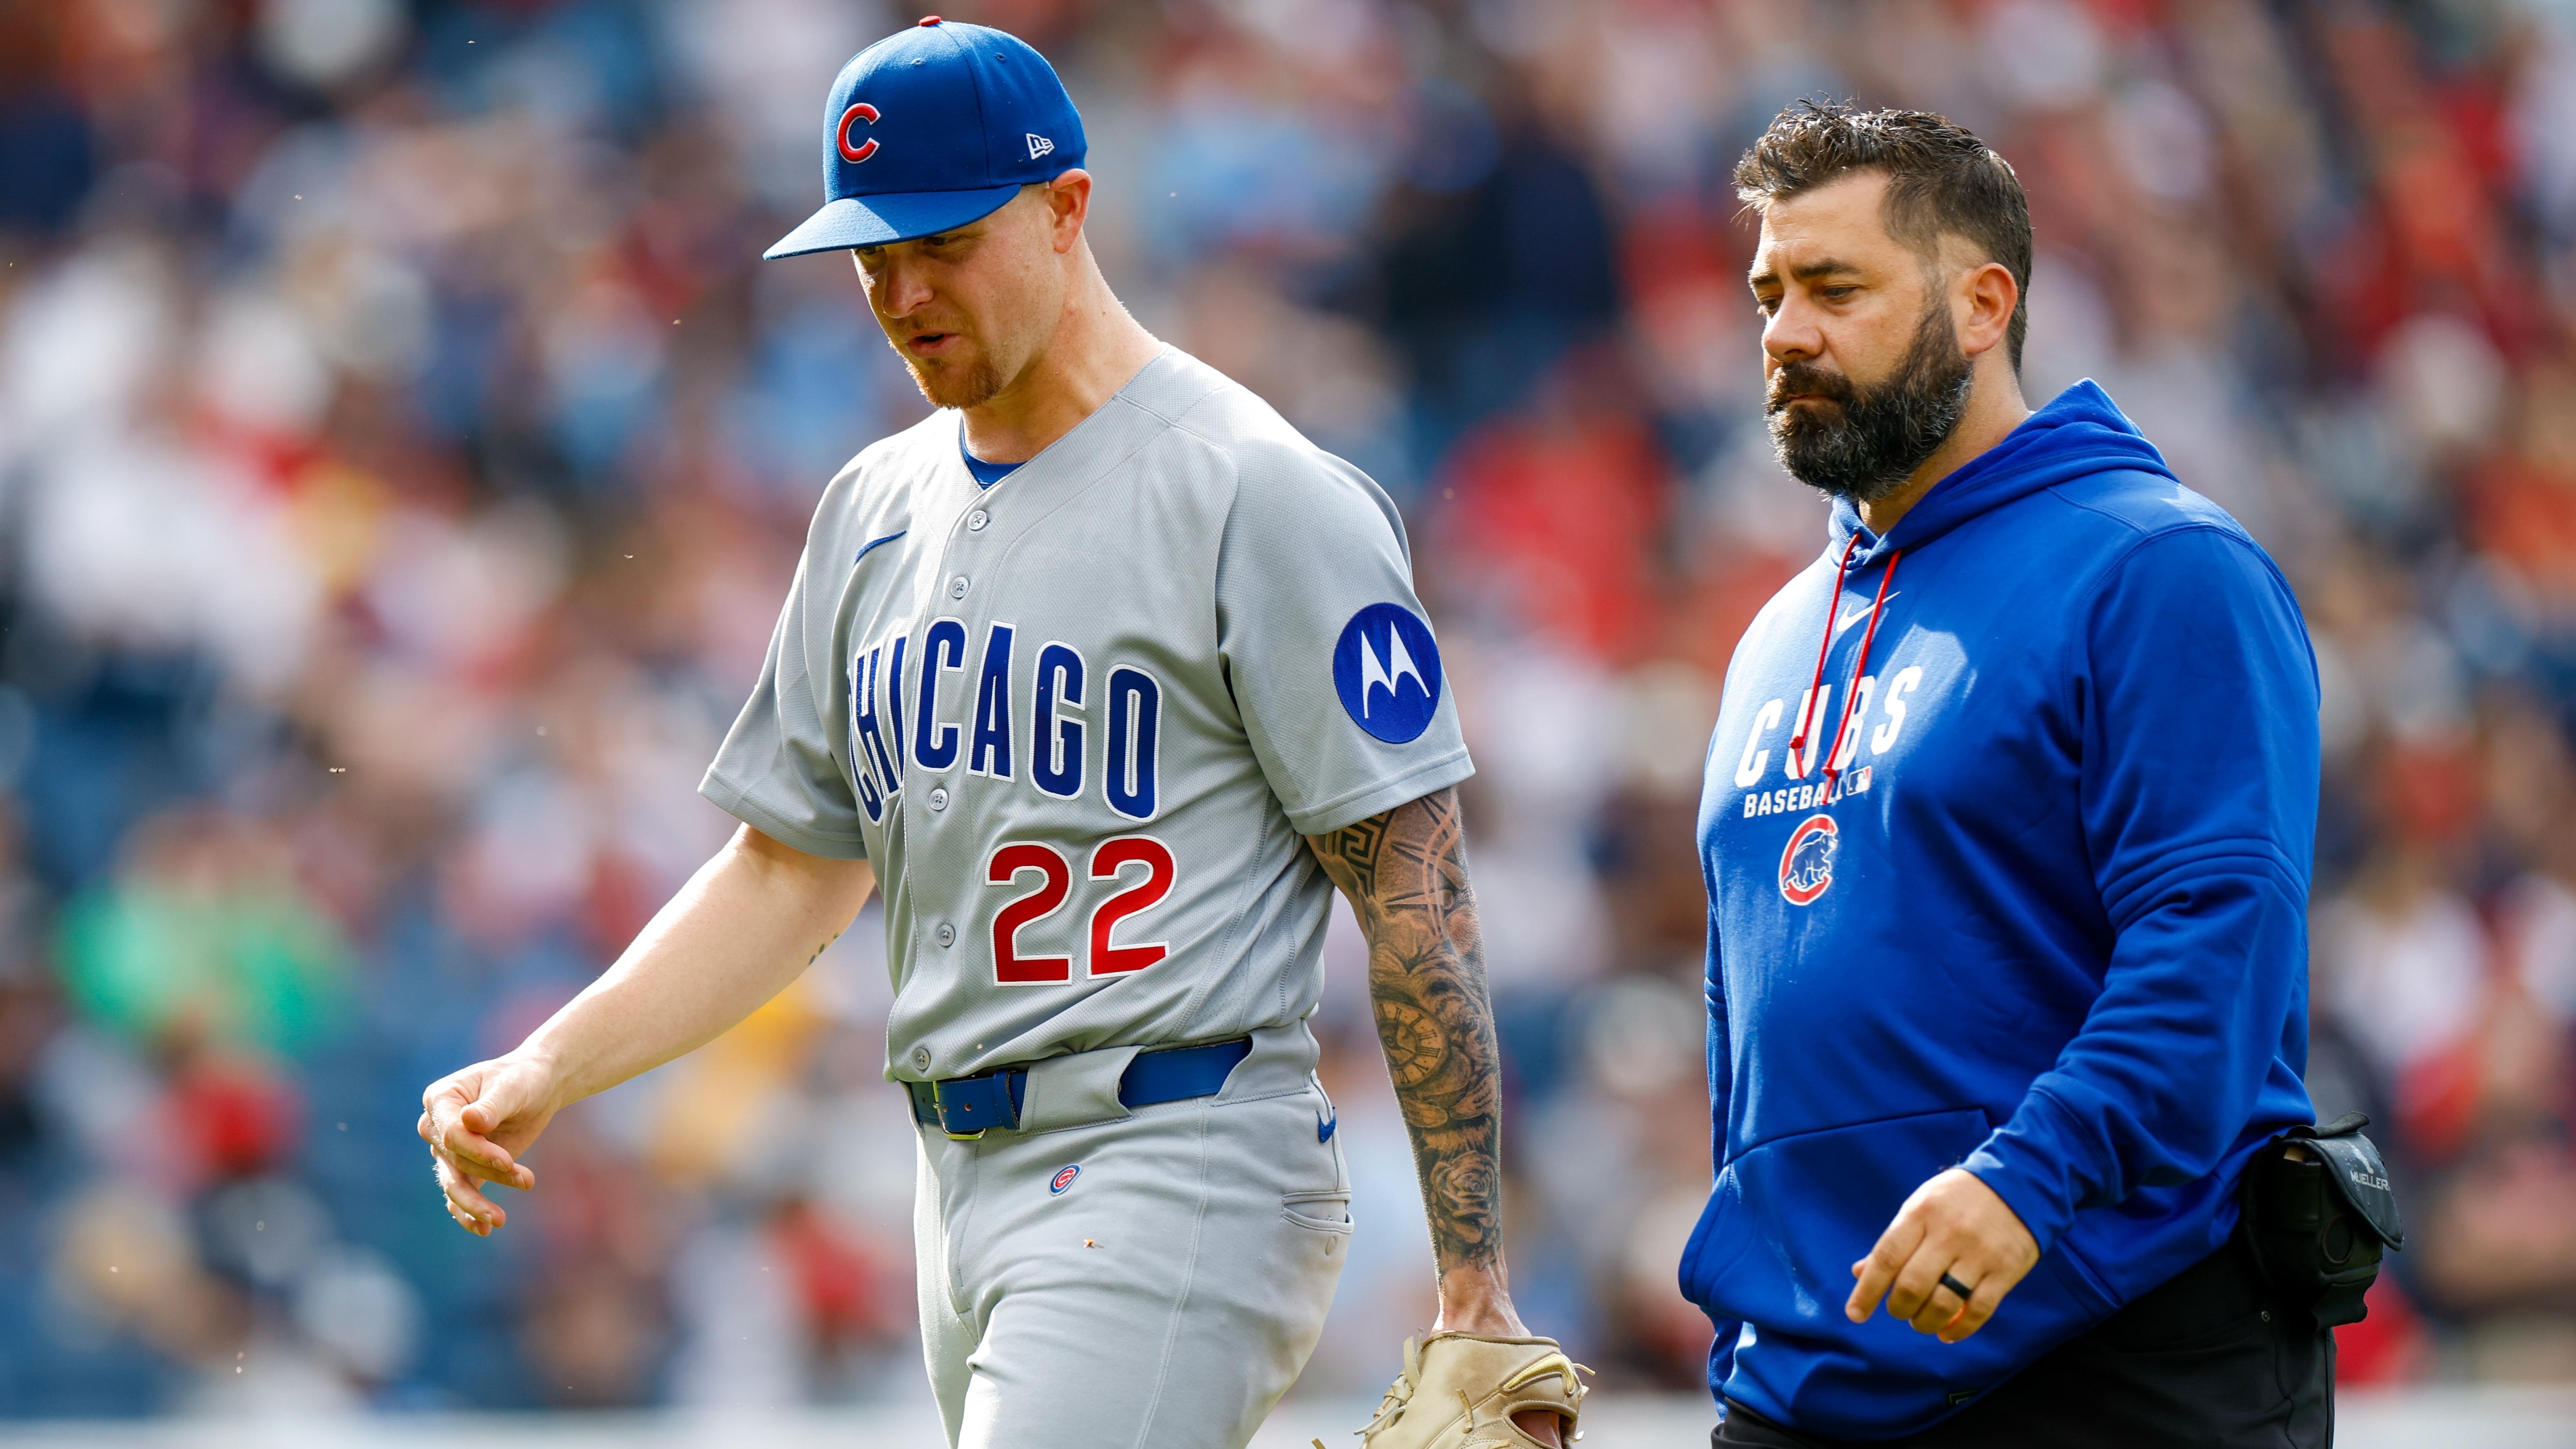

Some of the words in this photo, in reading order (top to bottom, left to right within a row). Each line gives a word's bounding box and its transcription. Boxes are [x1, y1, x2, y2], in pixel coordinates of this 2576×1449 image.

[837, 103, 880, 164] C
[847, 617, 1162, 826] CHICAGO
[1734, 666, 1923, 788] CUBS
[985, 834, 1178, 986] 22
